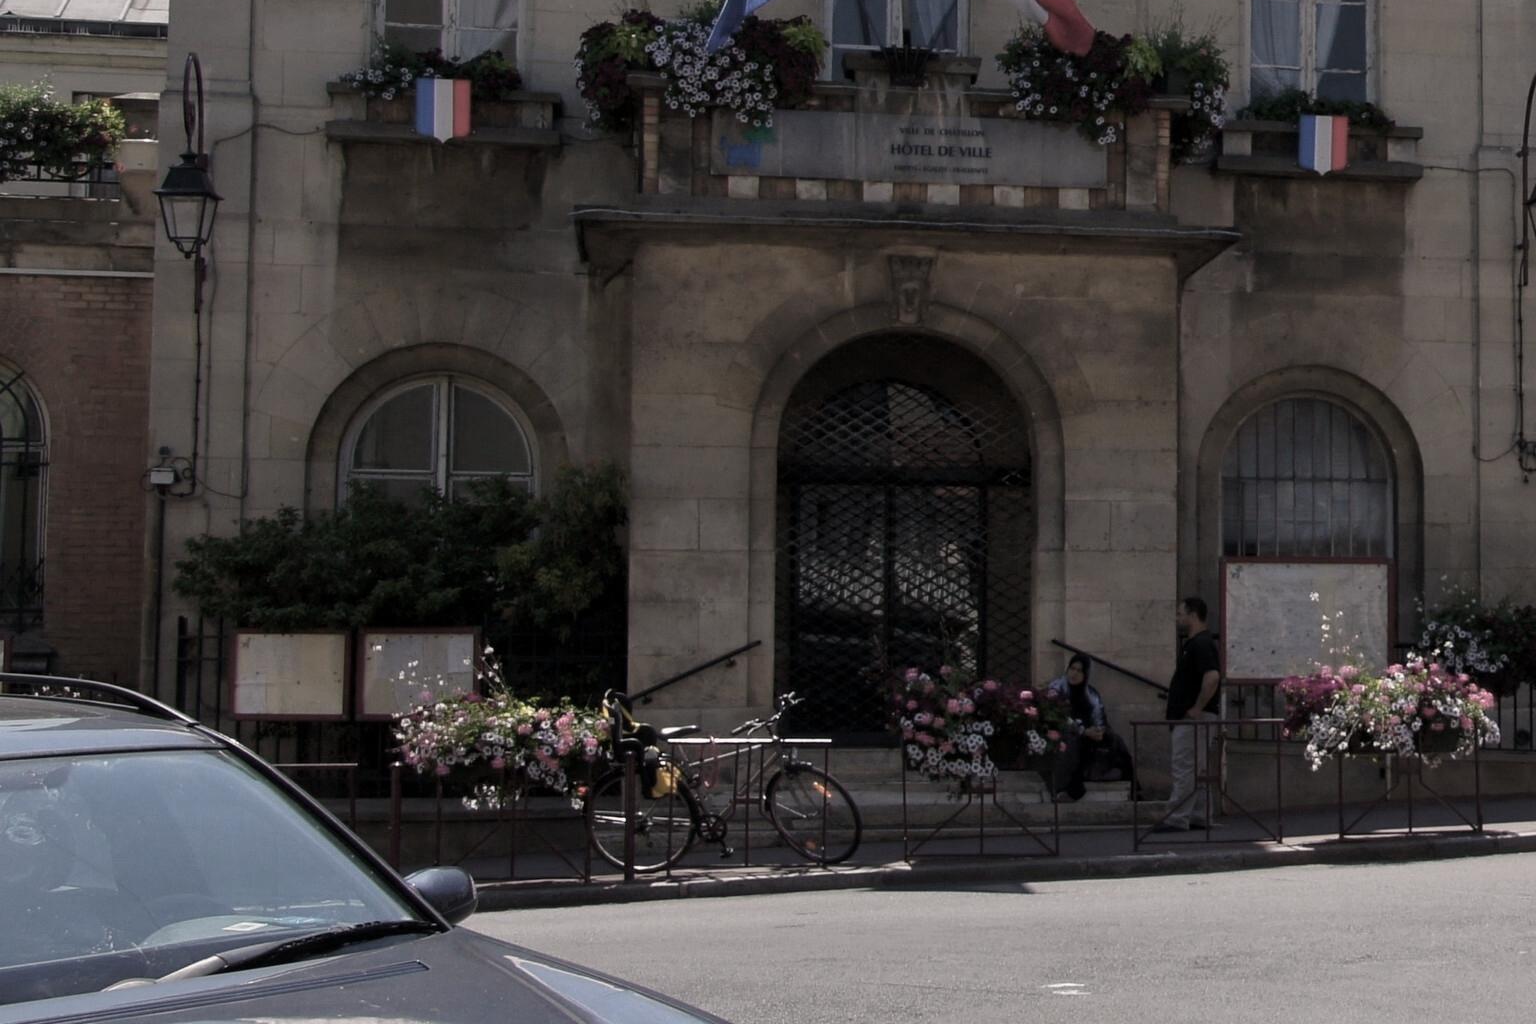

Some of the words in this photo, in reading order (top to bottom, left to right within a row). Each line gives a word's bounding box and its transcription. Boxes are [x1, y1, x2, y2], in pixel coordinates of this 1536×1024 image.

[891, 142, 934, 156] HÔTEL
[937, 145, 955, 157] DE
[958, 146, 993, 158] VILLE
